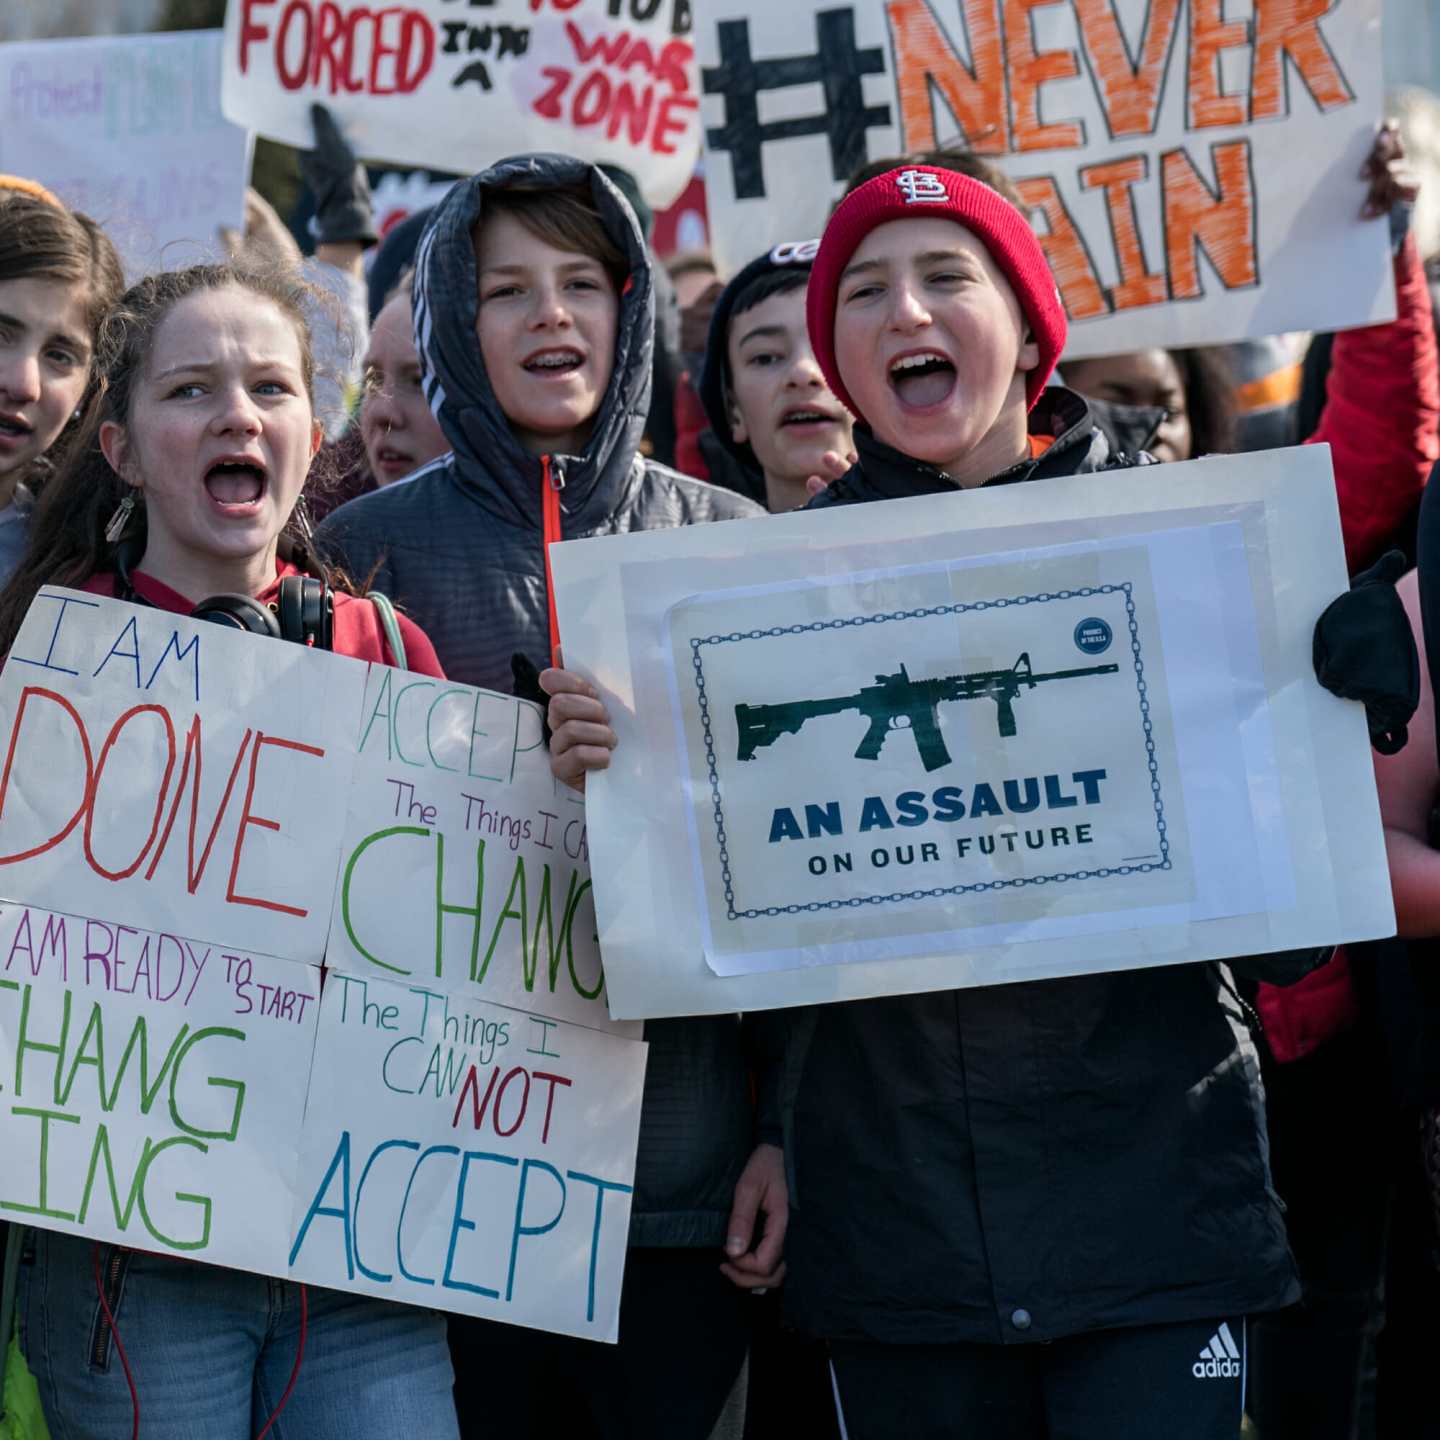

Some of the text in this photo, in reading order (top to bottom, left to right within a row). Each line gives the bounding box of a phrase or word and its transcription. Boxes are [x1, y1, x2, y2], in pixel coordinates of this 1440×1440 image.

[239, 0, 436, 95] FORCED
[451, 60, 493, 91] A
[565, 19, 695, 94] WAR
[532, 66, 699, 154] ZONE
[1015, 138, 1261, 321] AIN
[11, 594, 199, 701] I AM
[358, 669, 547, 785] ACCEP
[387, 778, 437, 826] The
[461, 792, 532, 850] Things
[534, 810, 559, 849] I
[768, 769, 1108, 843] AN ASSAULT
[808, 824, 1095, 876] ON OUR FUTURE
[5, 909, 68, 982] AM
[83, 919, 211, 1006] READY
[221, 954, 253, 987] TO
[343, 826, 609, 1008] CHANG
[235, 982, 315, 1024] START
[332, 974, 560, 1064] The Things I
[0, 1106, 212, 1250] ING
[289, 1131, 632, 1322] ACCEPT
[1192, 1358, 1241, 1378] adida
